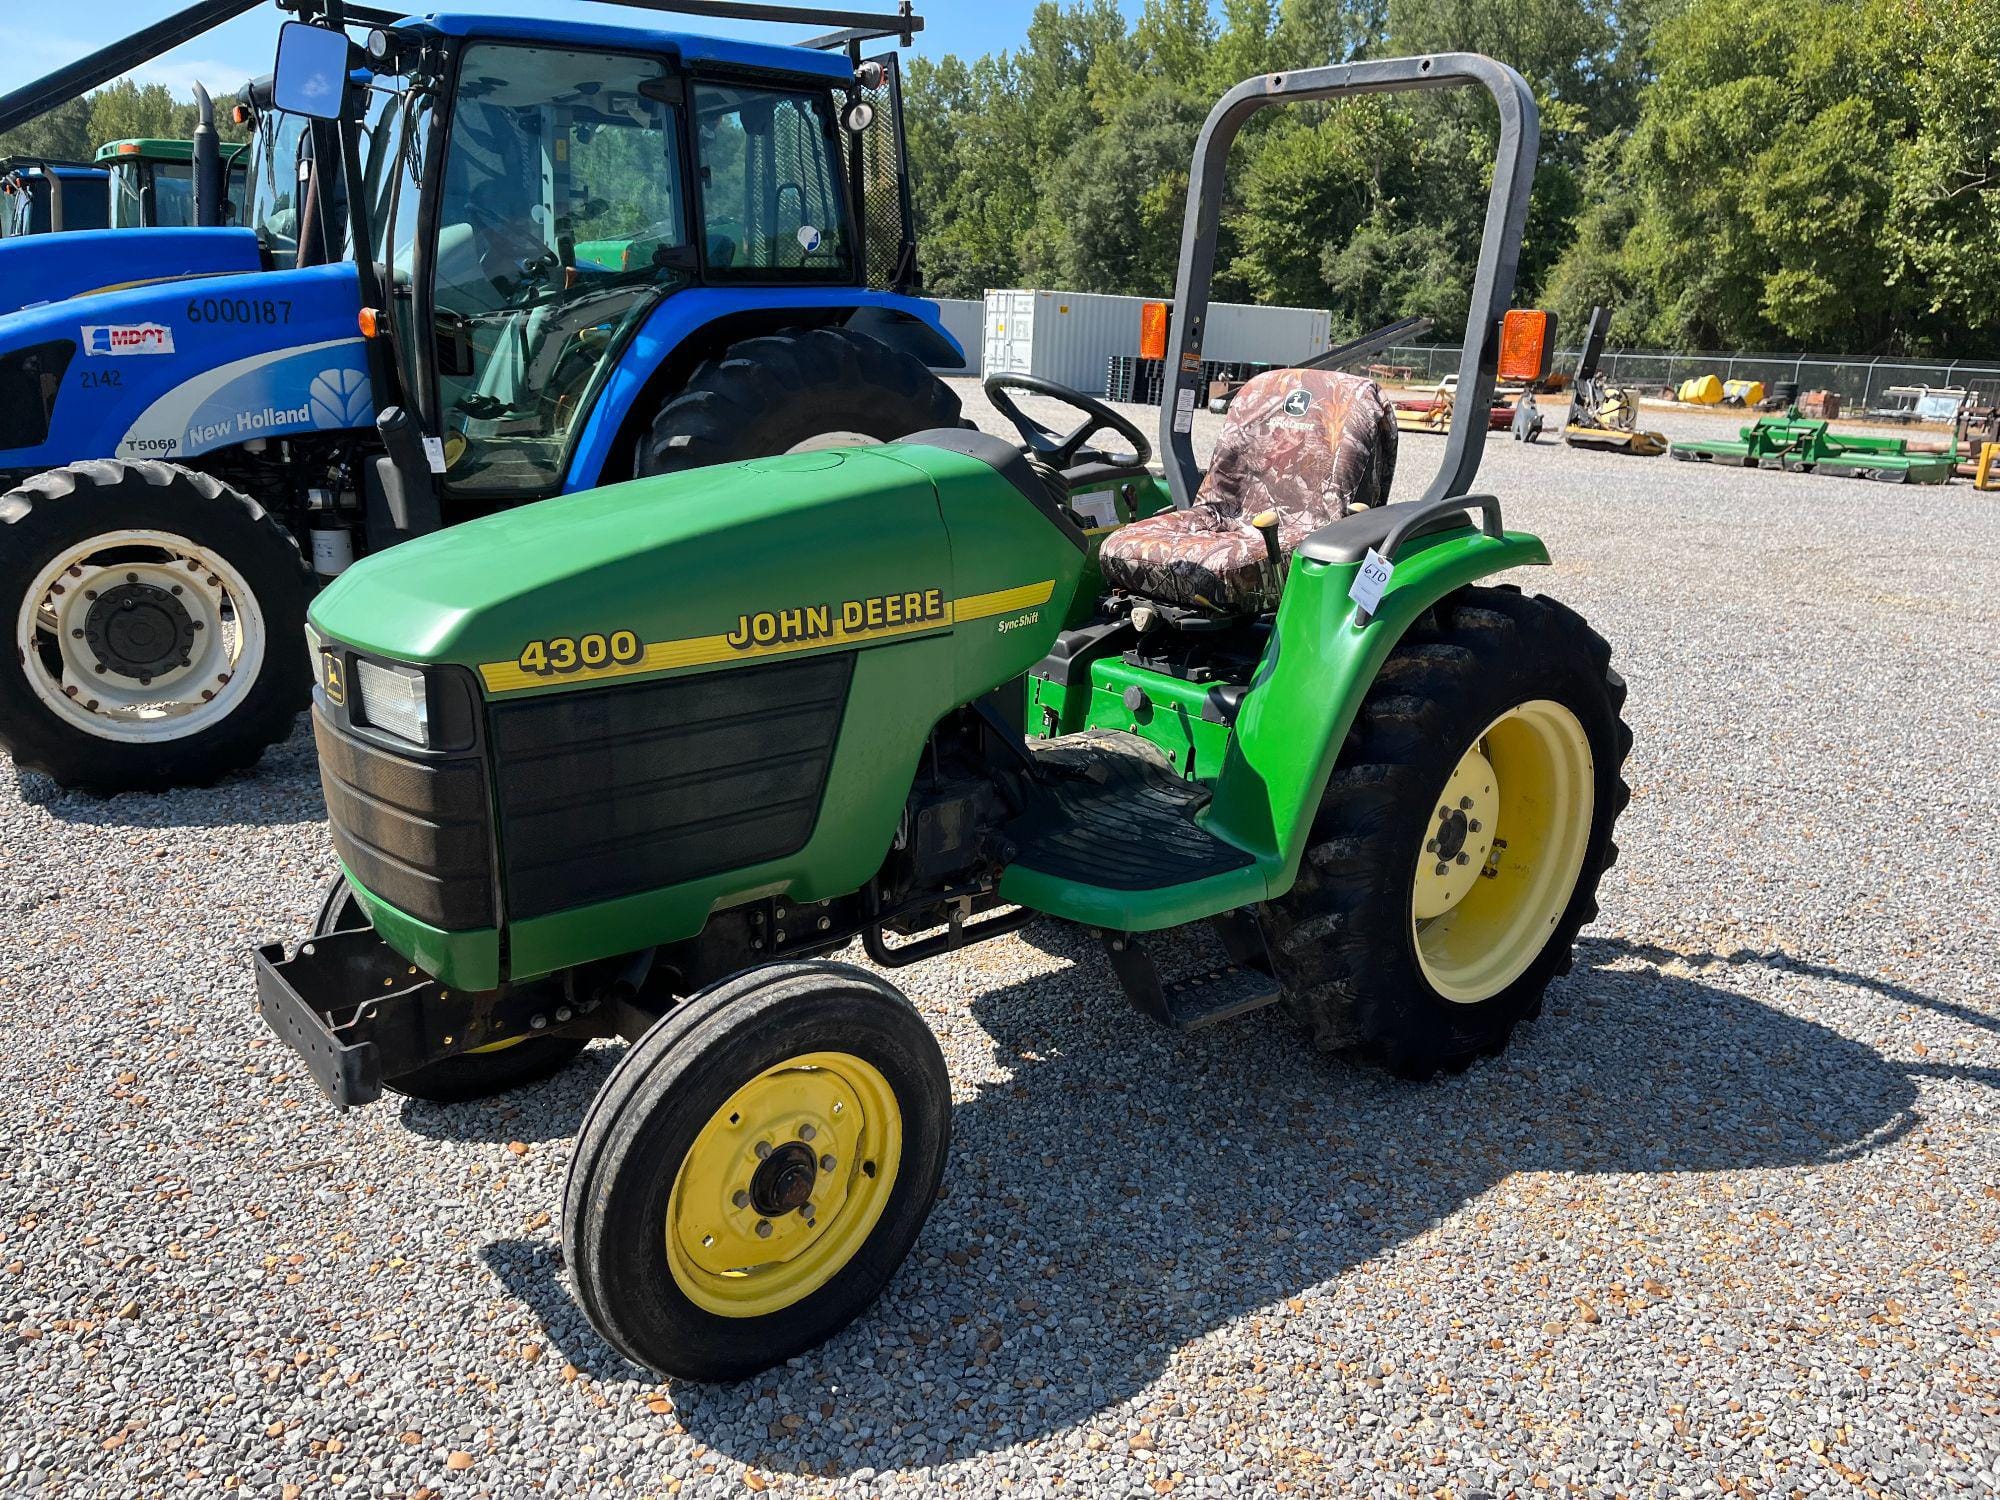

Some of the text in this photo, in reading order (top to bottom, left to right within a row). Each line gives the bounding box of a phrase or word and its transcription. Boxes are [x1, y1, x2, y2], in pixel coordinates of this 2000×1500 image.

[187, 299, 292, 324] 6000187
[112, 329, 165, 346] MDOT
[81, 370, 122, 388] 2142
[190, 404, 309, 448] New Holland
[126, 439, 177, 452] T5060
[727, 589, 943, 648] JOHN DEERE
[518, 630, 643, 676] 4300
